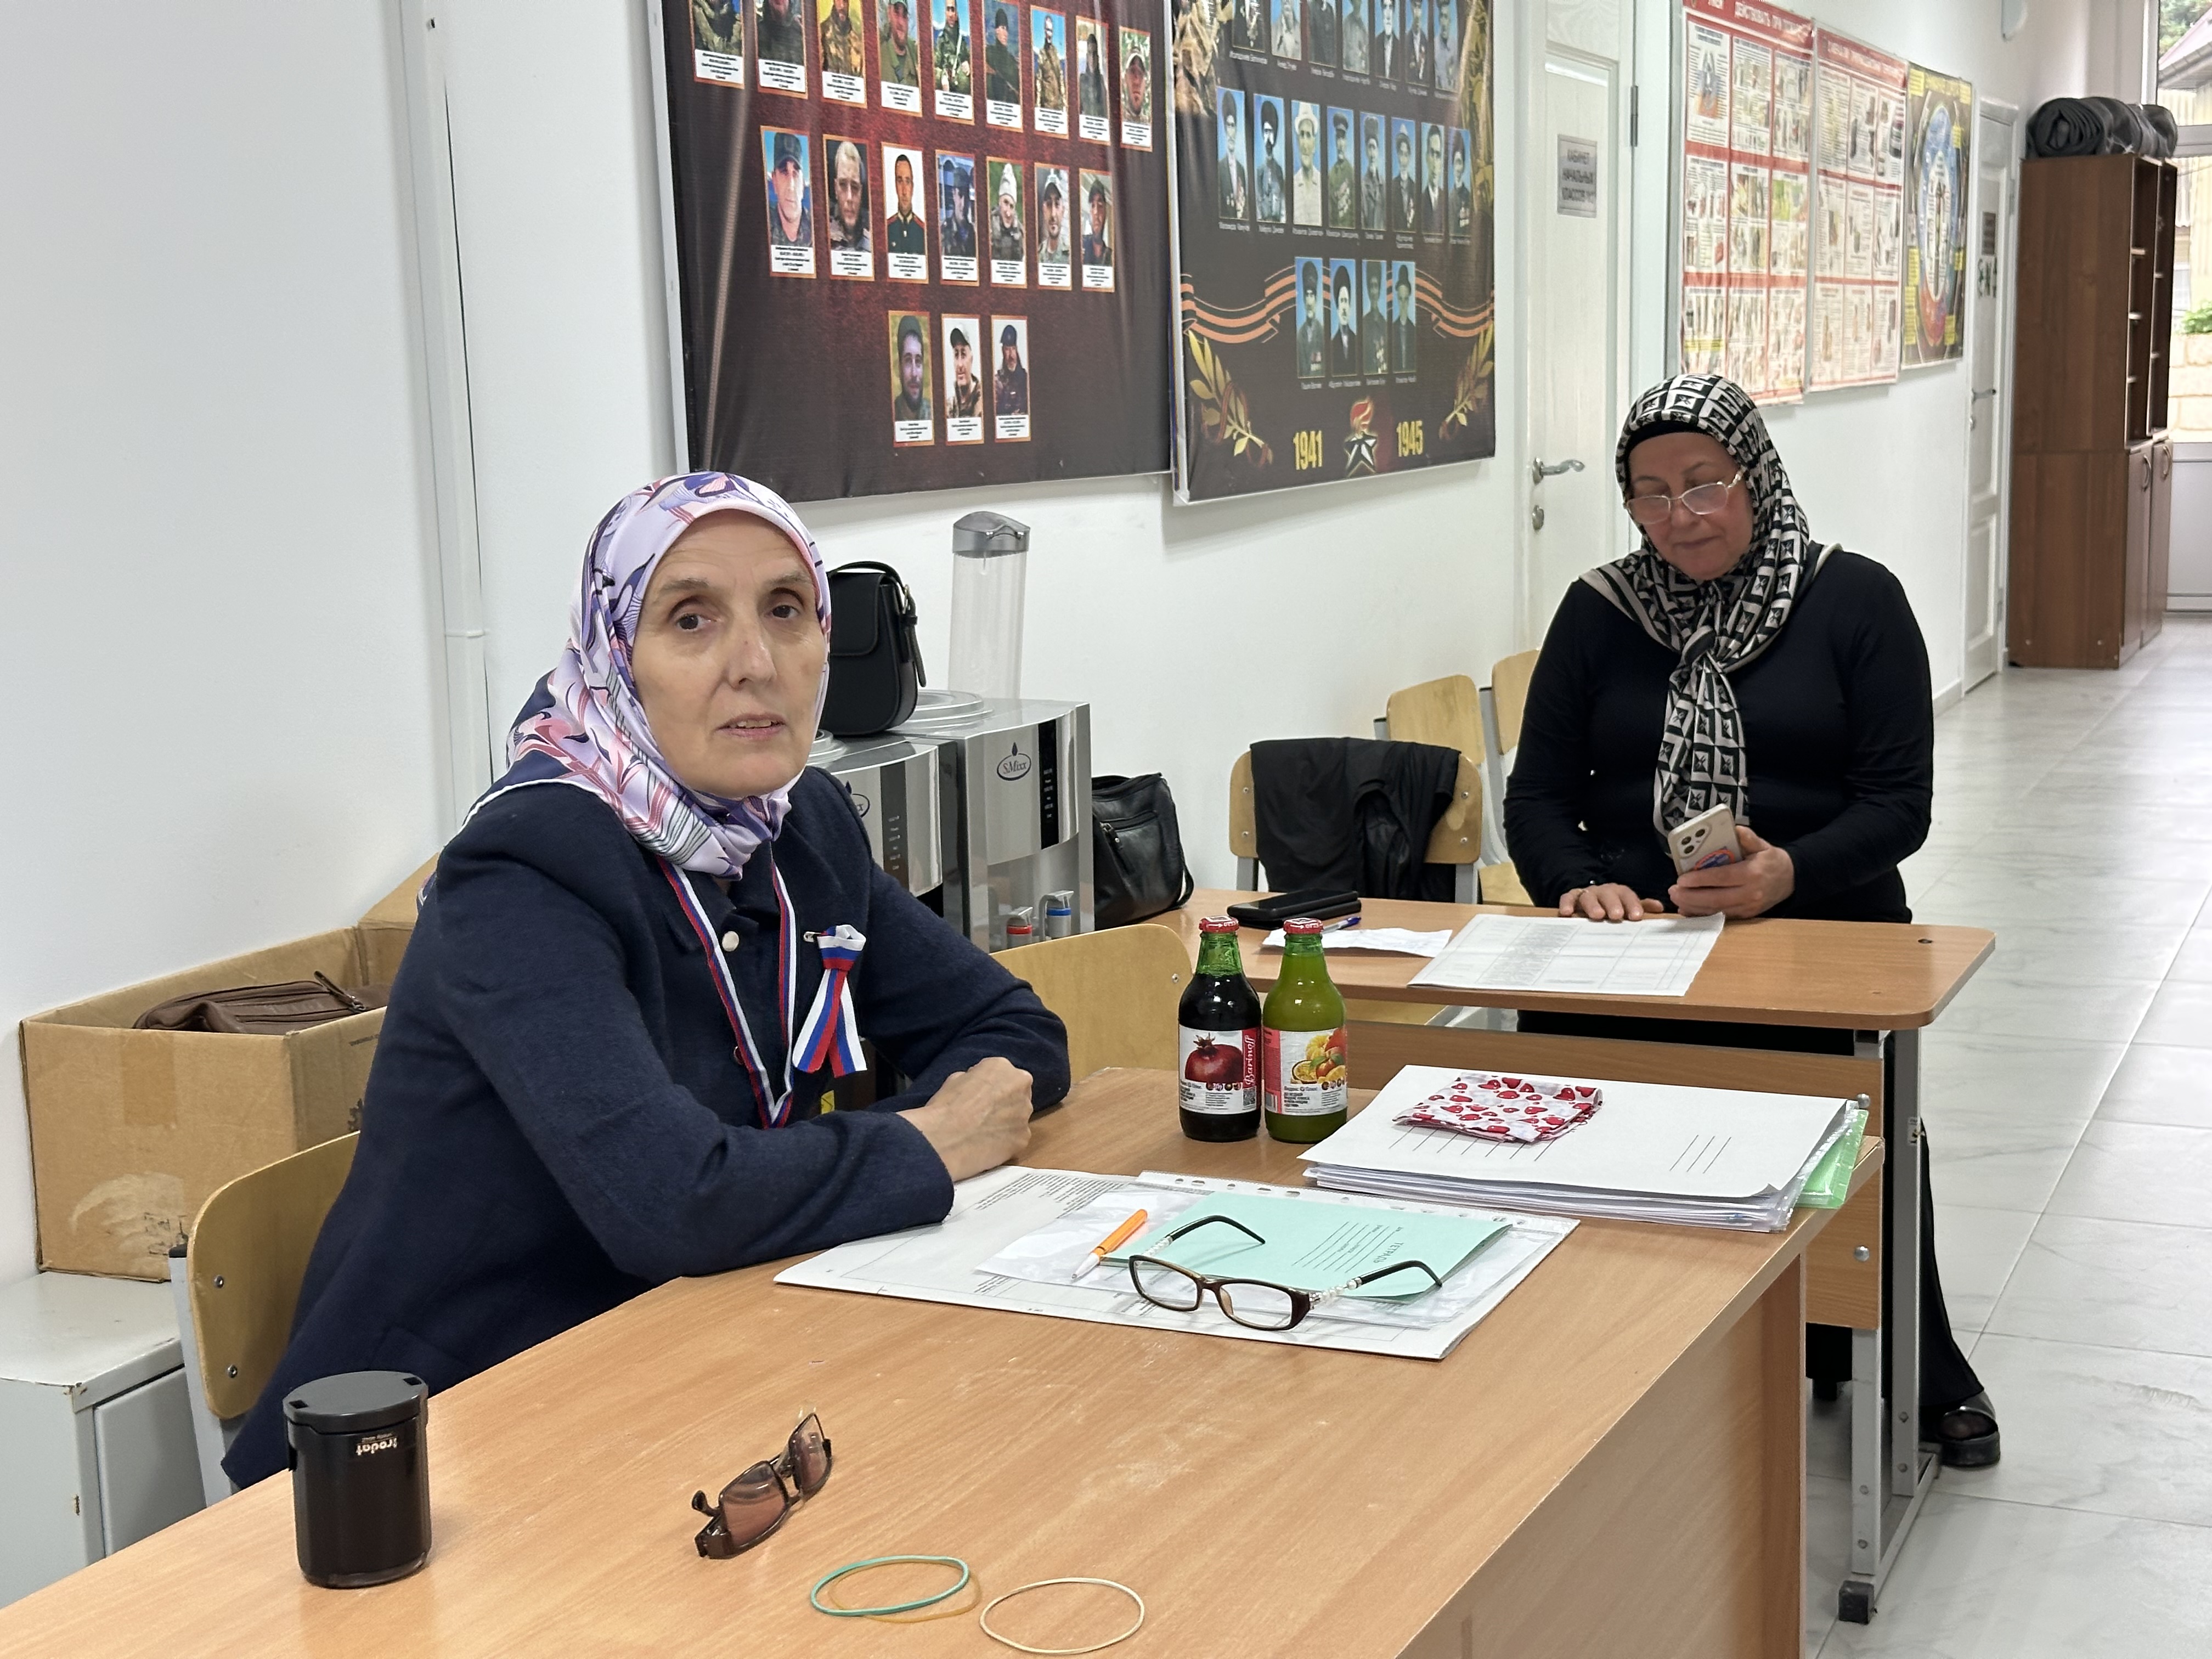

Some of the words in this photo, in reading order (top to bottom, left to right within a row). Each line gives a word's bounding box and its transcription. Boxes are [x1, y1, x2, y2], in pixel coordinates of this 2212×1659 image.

[1293, 430, 1322, 470] 1941
[1396, 420, 1423, 457] 1945
[1244, 1035, 1256, 1086] Barinoff
[1373, 1242, 1404, 1263] ТЕТРАДЬ
[356, 1437, 397, 1455] trodat
